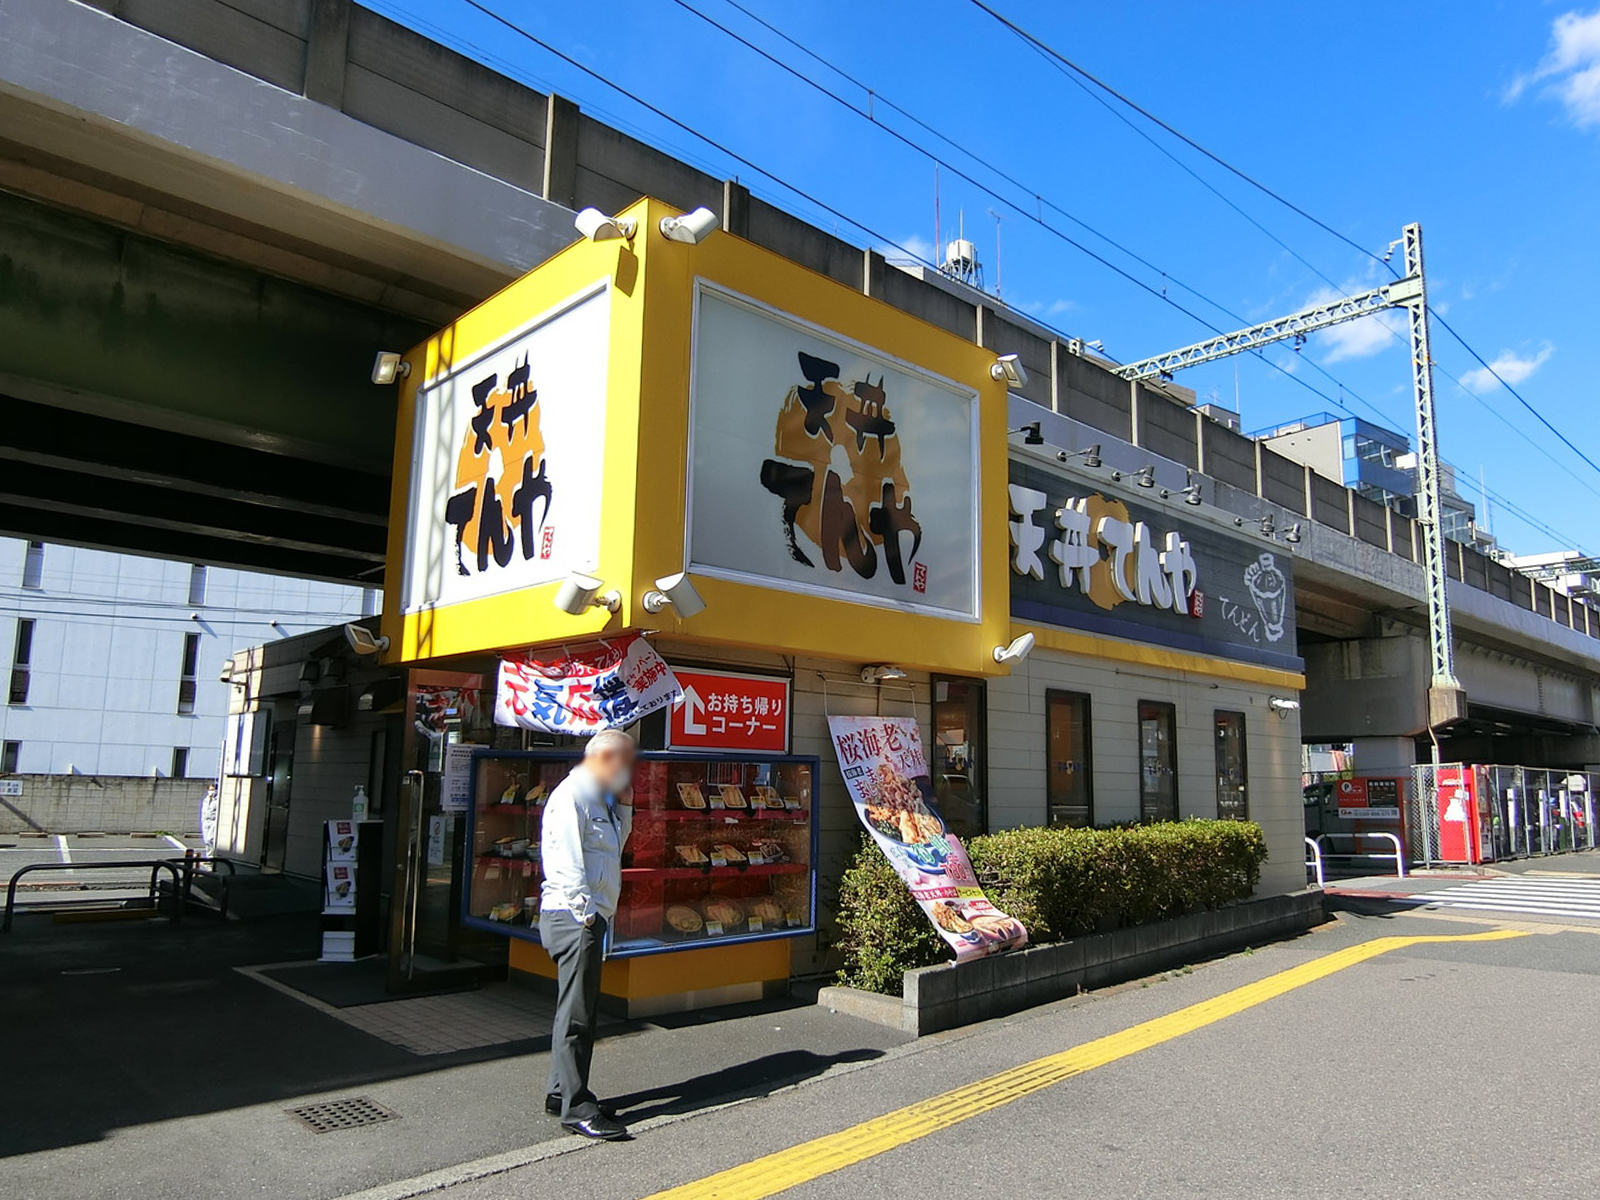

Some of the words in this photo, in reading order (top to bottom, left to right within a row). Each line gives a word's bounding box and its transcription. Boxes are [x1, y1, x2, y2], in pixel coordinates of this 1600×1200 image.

[472, 349, 537, 454] 天丼
[798, 351, 895, 460] 天丼
[446, 455, 552, 577] てんや
[760, 460, 922, 585] てんや
[503, 664, 640, 726] 元気応援
[632, 661, 667, 693] 実施中
[707, 692, 782, 717] お持ち帰り
[712, 716, 777, 736] コーナー
[836, 723, 903, 765] 桜海老
